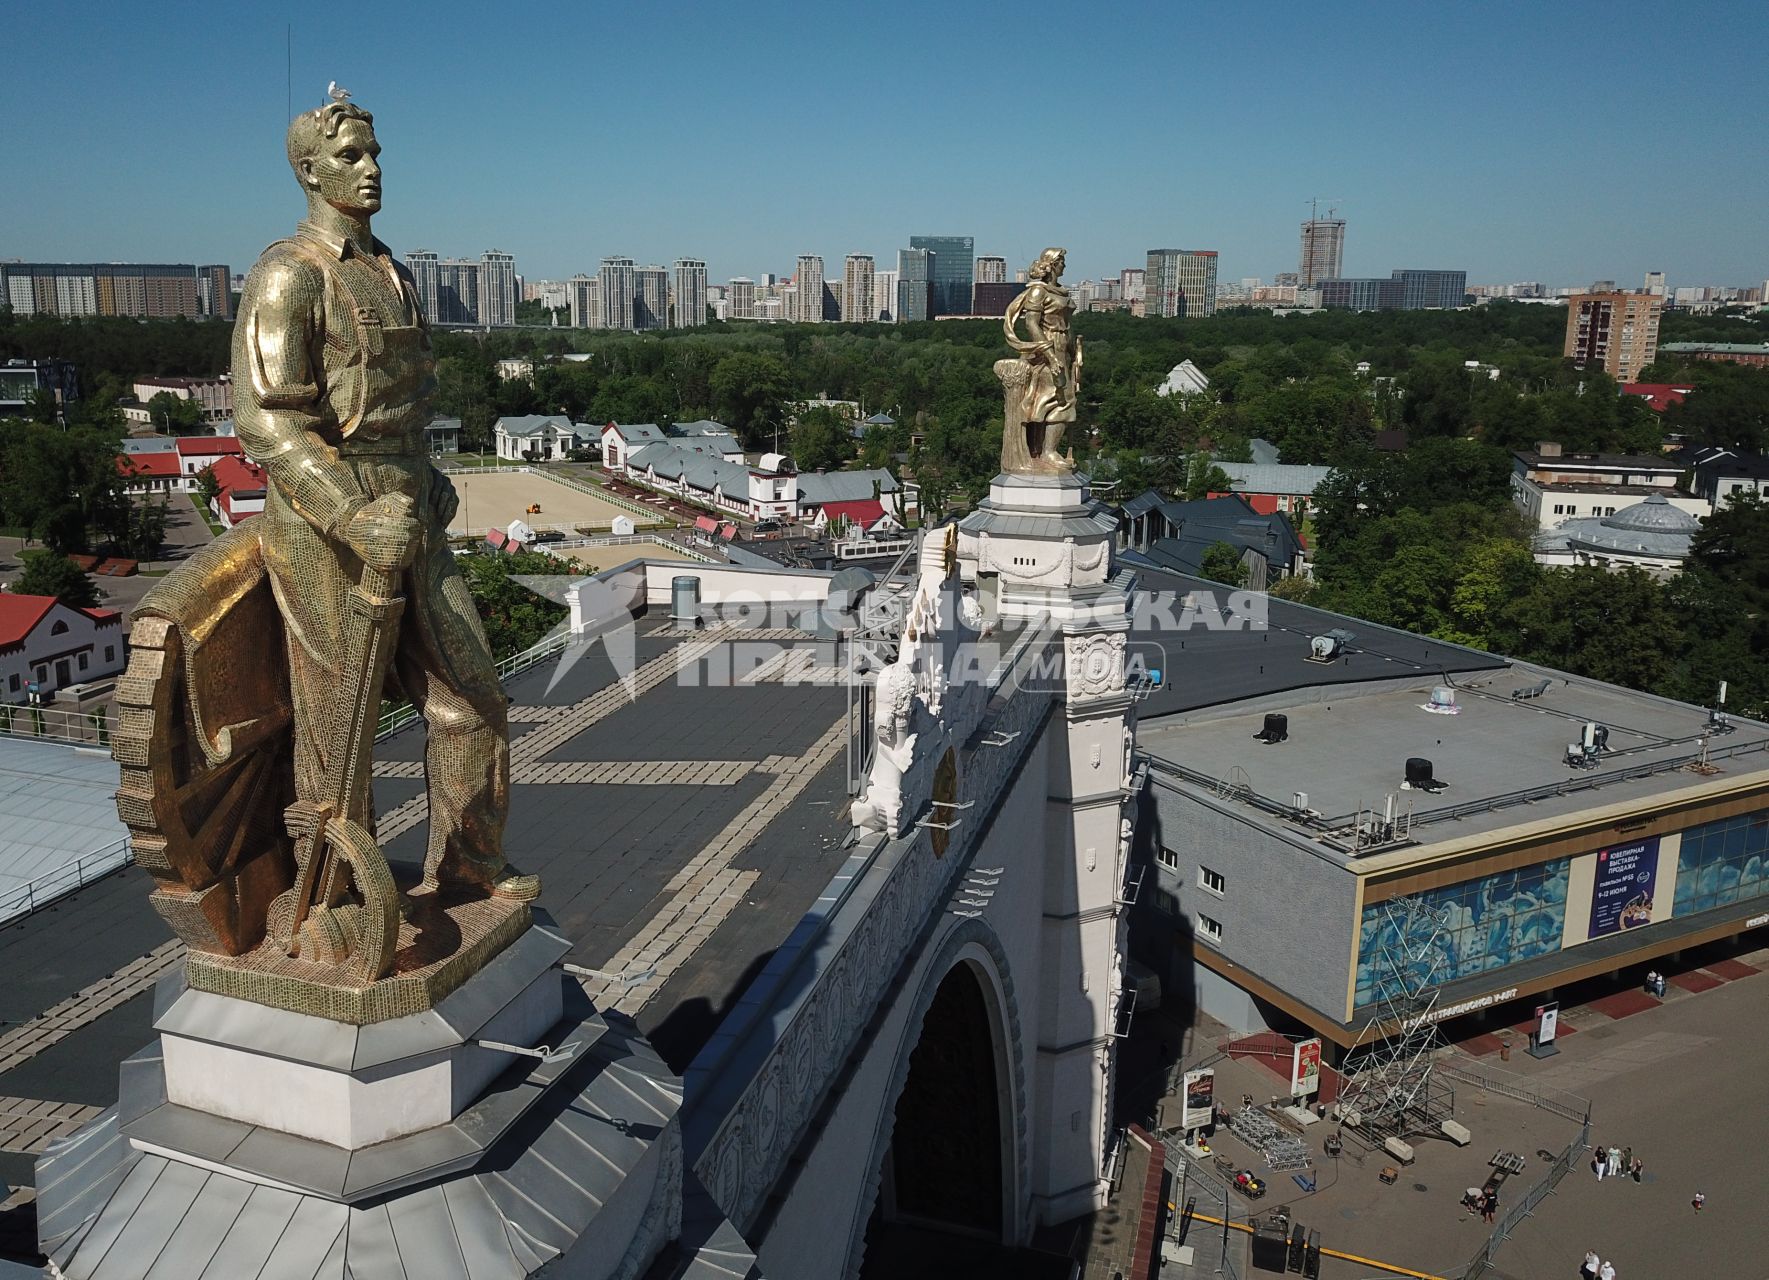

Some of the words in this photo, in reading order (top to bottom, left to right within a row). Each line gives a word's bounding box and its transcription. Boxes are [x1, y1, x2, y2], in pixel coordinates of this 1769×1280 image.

[1610, 846, 1645, 860] ЮВЕЛИРНАЯ
[1609, 855, 1640, 867] ВЫСТАВКА-
[1608, 863, 1636, 874] ПРОДАЖА
